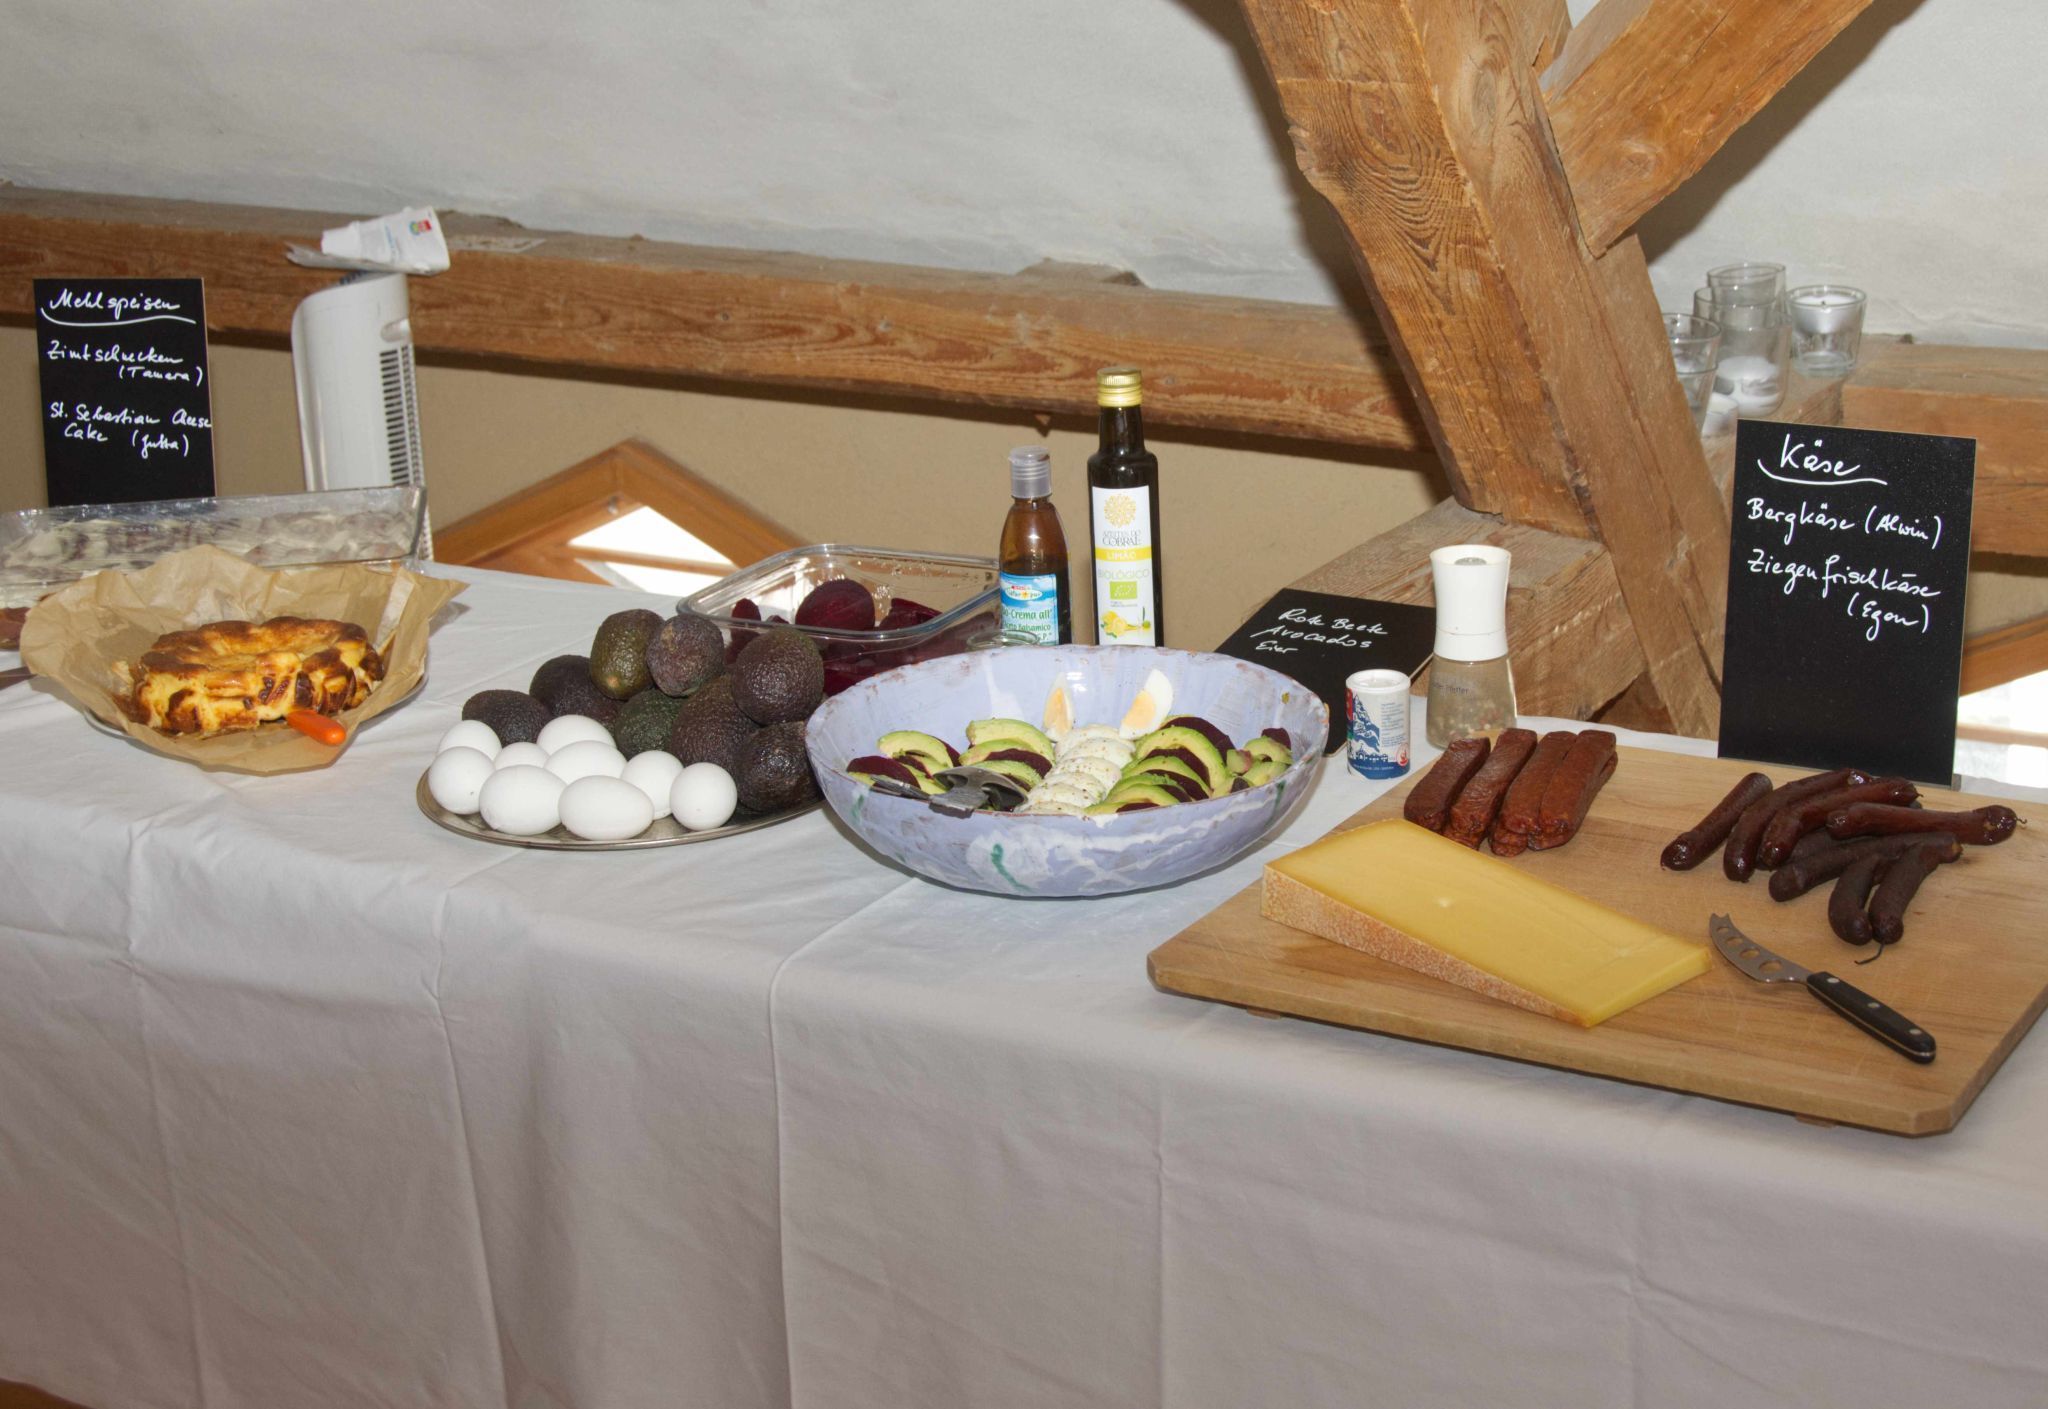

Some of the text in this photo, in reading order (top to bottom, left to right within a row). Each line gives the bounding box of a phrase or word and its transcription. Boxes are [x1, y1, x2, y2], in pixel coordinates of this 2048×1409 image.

[50, 288, 181, 320] Mehlspeisen
[47, 340, 184, 364] Zimtschnecken
[50, 402, 68, 419] St.
[75, 403, 161, 425] Sebastian
[64, 422, 108, 442] Cake
[1780, 433, 1861, 476] Käse
[1746, 497, 1856, 546] Bergkäse
[1277, 608, 1325, 626] Rote
[1847, 592, 1930, 642] (Egon)
[1249, 625, 1373, 649] Avocados
[1255, 640, 1299, 654] Eier
